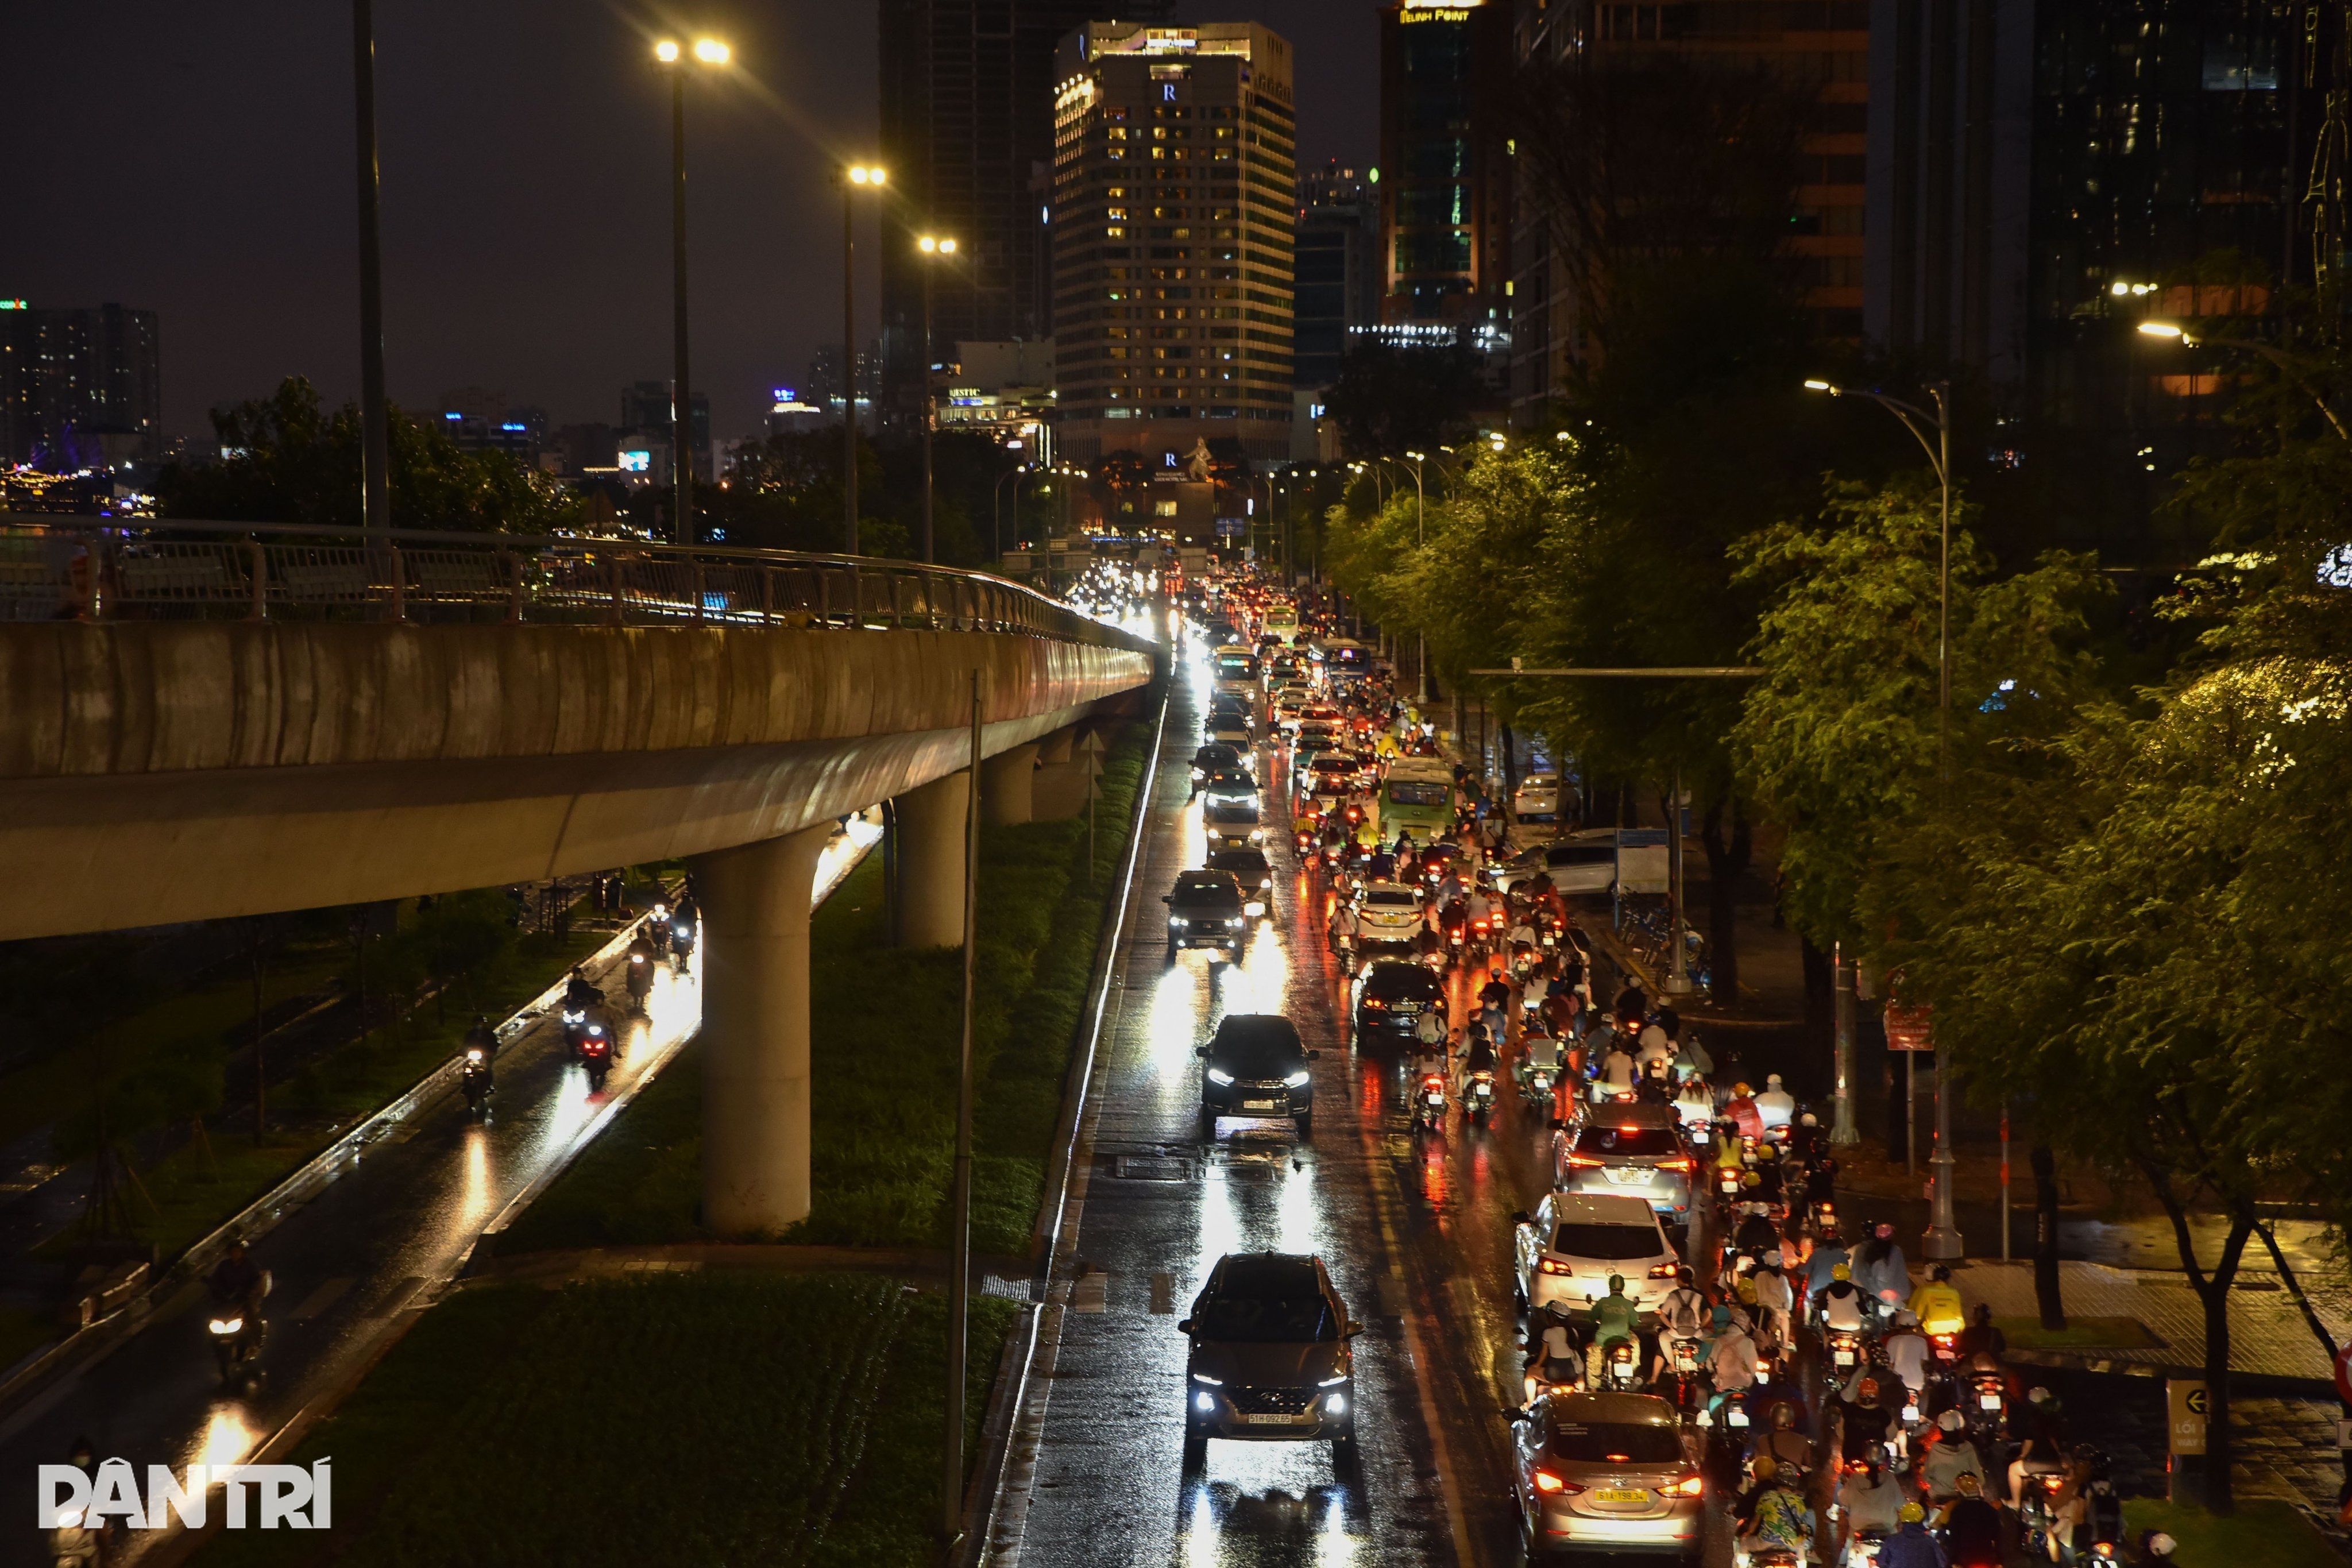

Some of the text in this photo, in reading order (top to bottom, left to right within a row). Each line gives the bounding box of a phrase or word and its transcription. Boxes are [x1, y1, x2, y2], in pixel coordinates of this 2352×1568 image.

[1435, 8, 1469, 21] POINT
[1164, 83, 1176, 101] R
[1165, 453, 1177, 466] R
